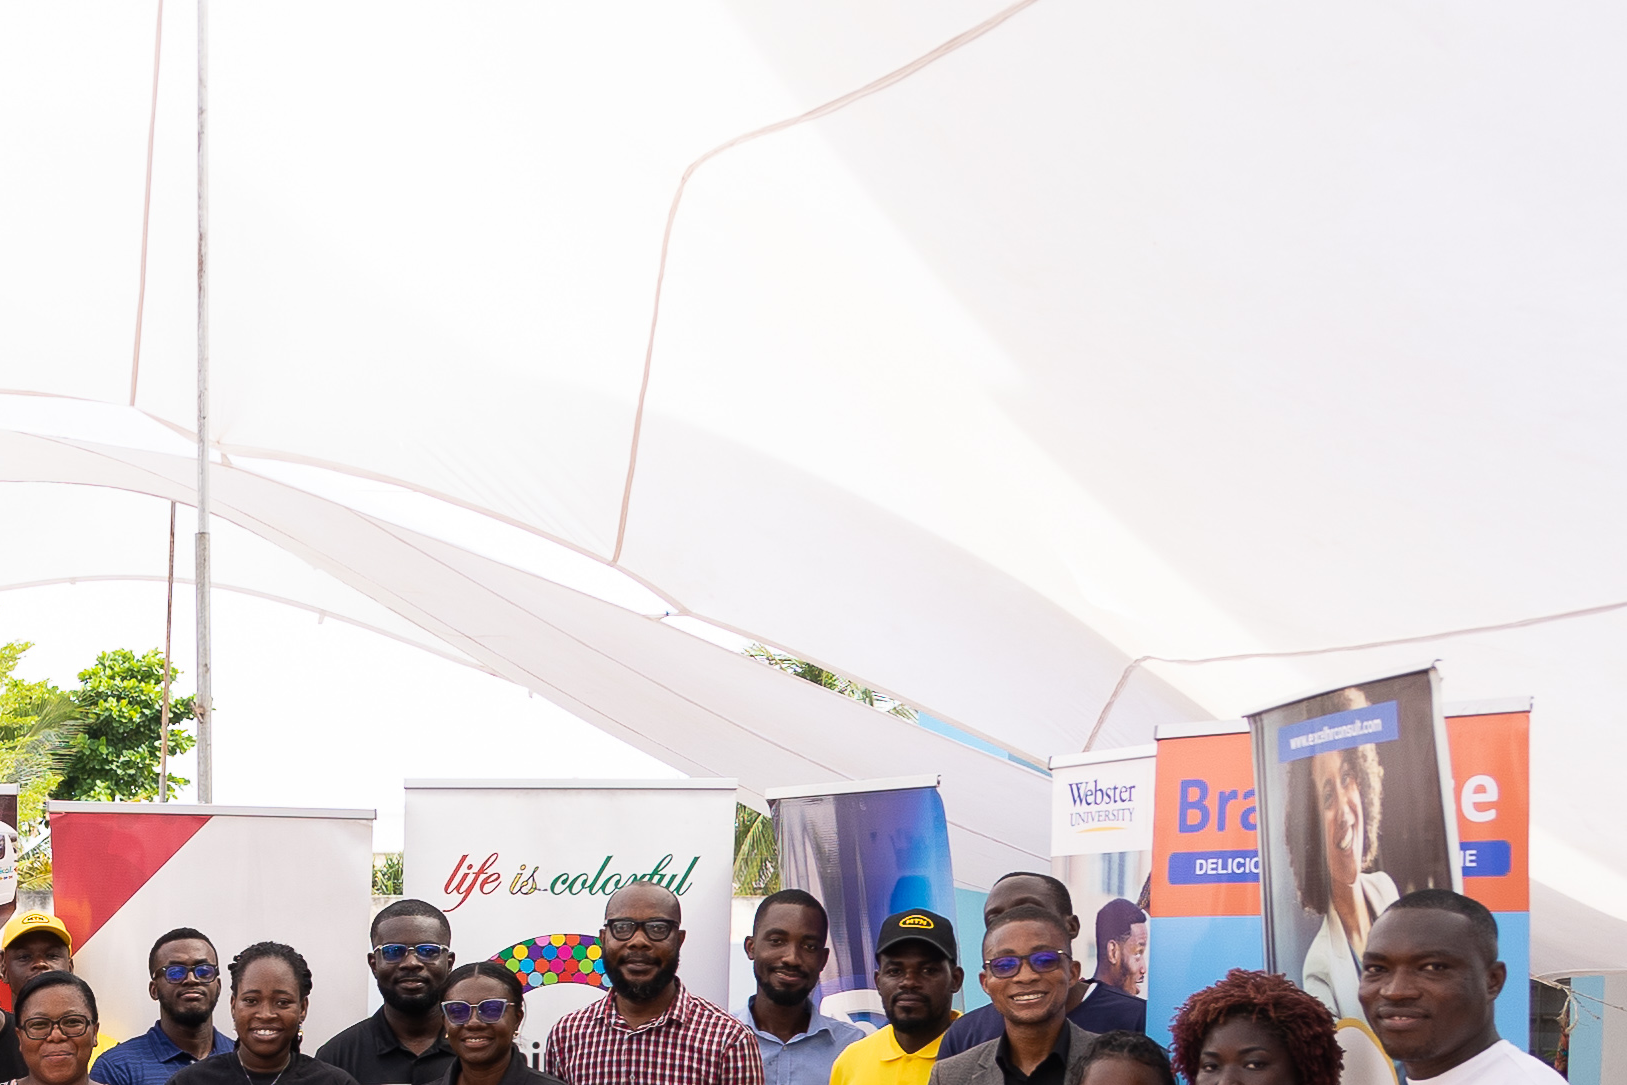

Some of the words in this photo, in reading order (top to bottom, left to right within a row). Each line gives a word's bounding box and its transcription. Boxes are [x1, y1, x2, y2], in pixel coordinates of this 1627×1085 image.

[1067, 779, 1136, 808] Webster
[1069, 807, 1135, 828] UNIVERSITY
[442, 852, 502, 913] life
[509, 864, 548, 896] is
